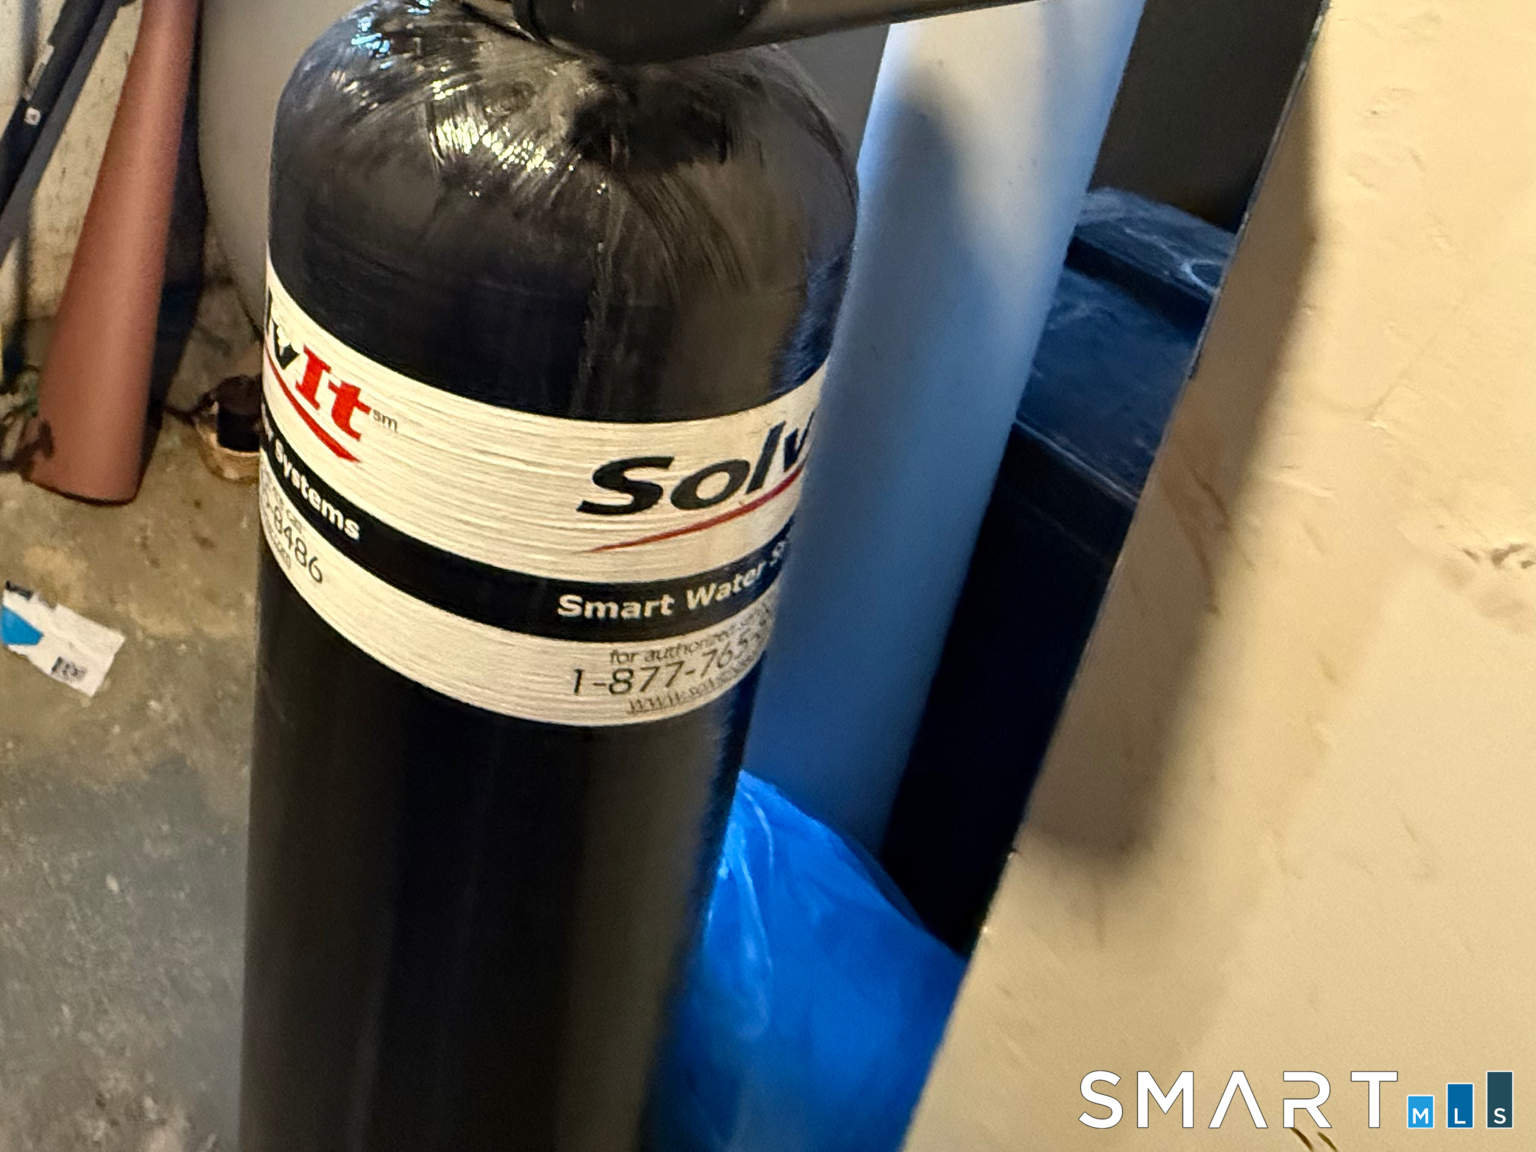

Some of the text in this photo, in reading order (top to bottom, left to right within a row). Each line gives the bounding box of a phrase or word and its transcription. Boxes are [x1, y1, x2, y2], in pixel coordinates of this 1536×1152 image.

[274, 438, 361, 541] Systems
[557, 560, 766, 620] Smart Water
[610, 649, 637, 665] for
